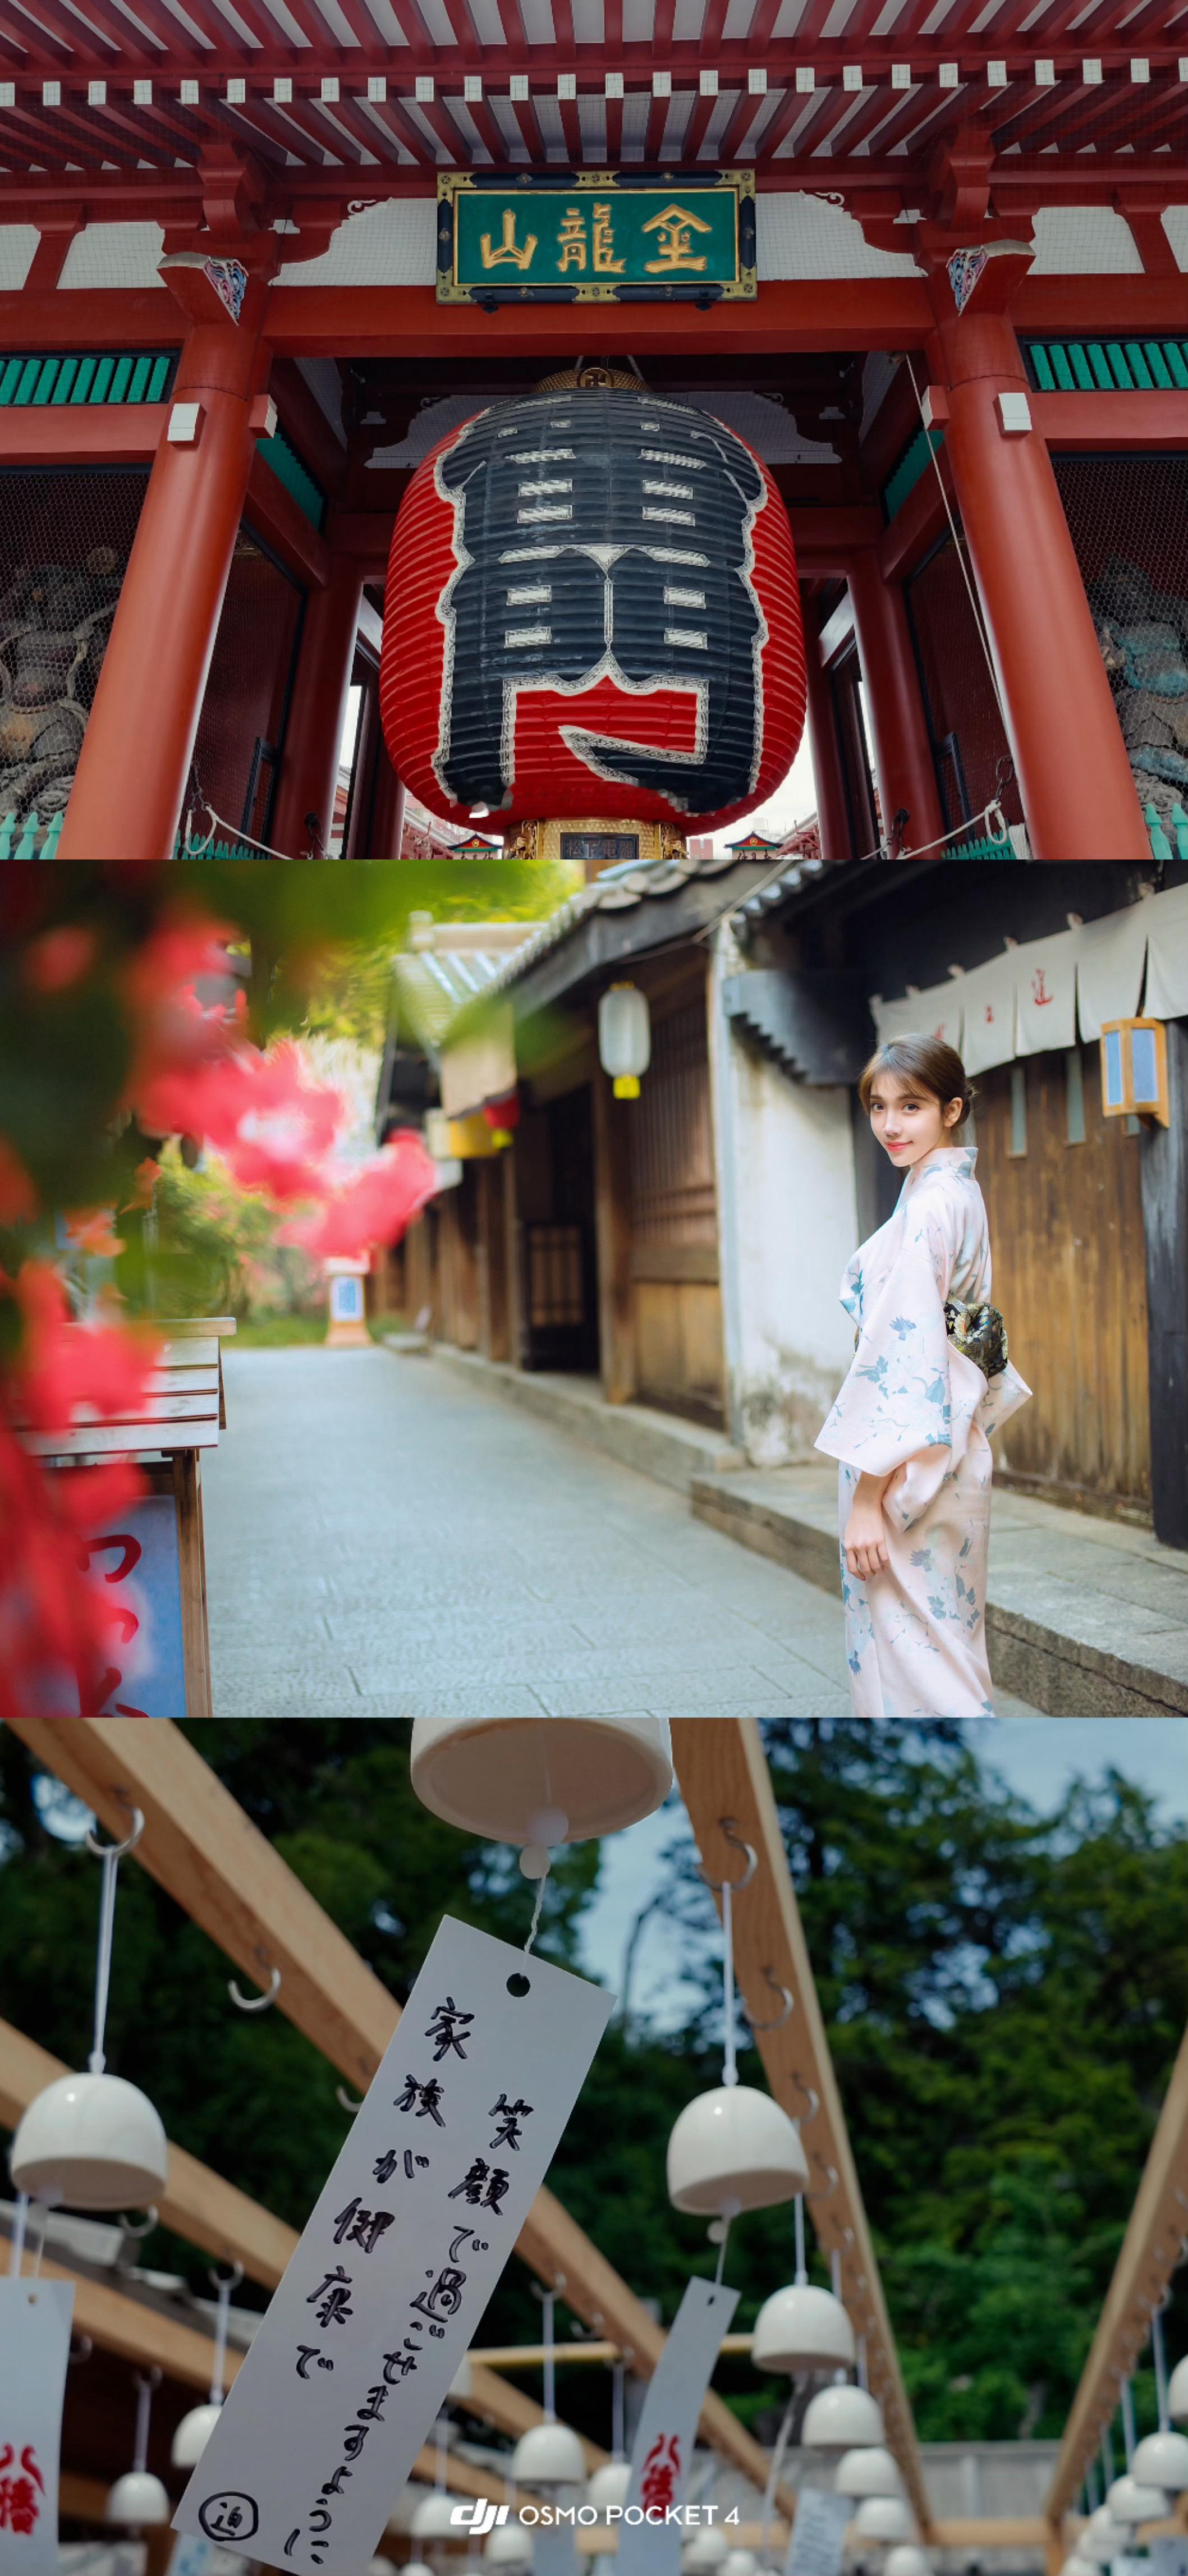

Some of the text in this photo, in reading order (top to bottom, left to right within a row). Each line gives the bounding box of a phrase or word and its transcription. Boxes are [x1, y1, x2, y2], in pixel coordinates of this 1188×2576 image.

[430, 388, 768, 817] 雷門
[284, 2093, 534, 2564] 笑顔で過ごせますように
[296, 1997, 475, 2379] 家族が健康で
